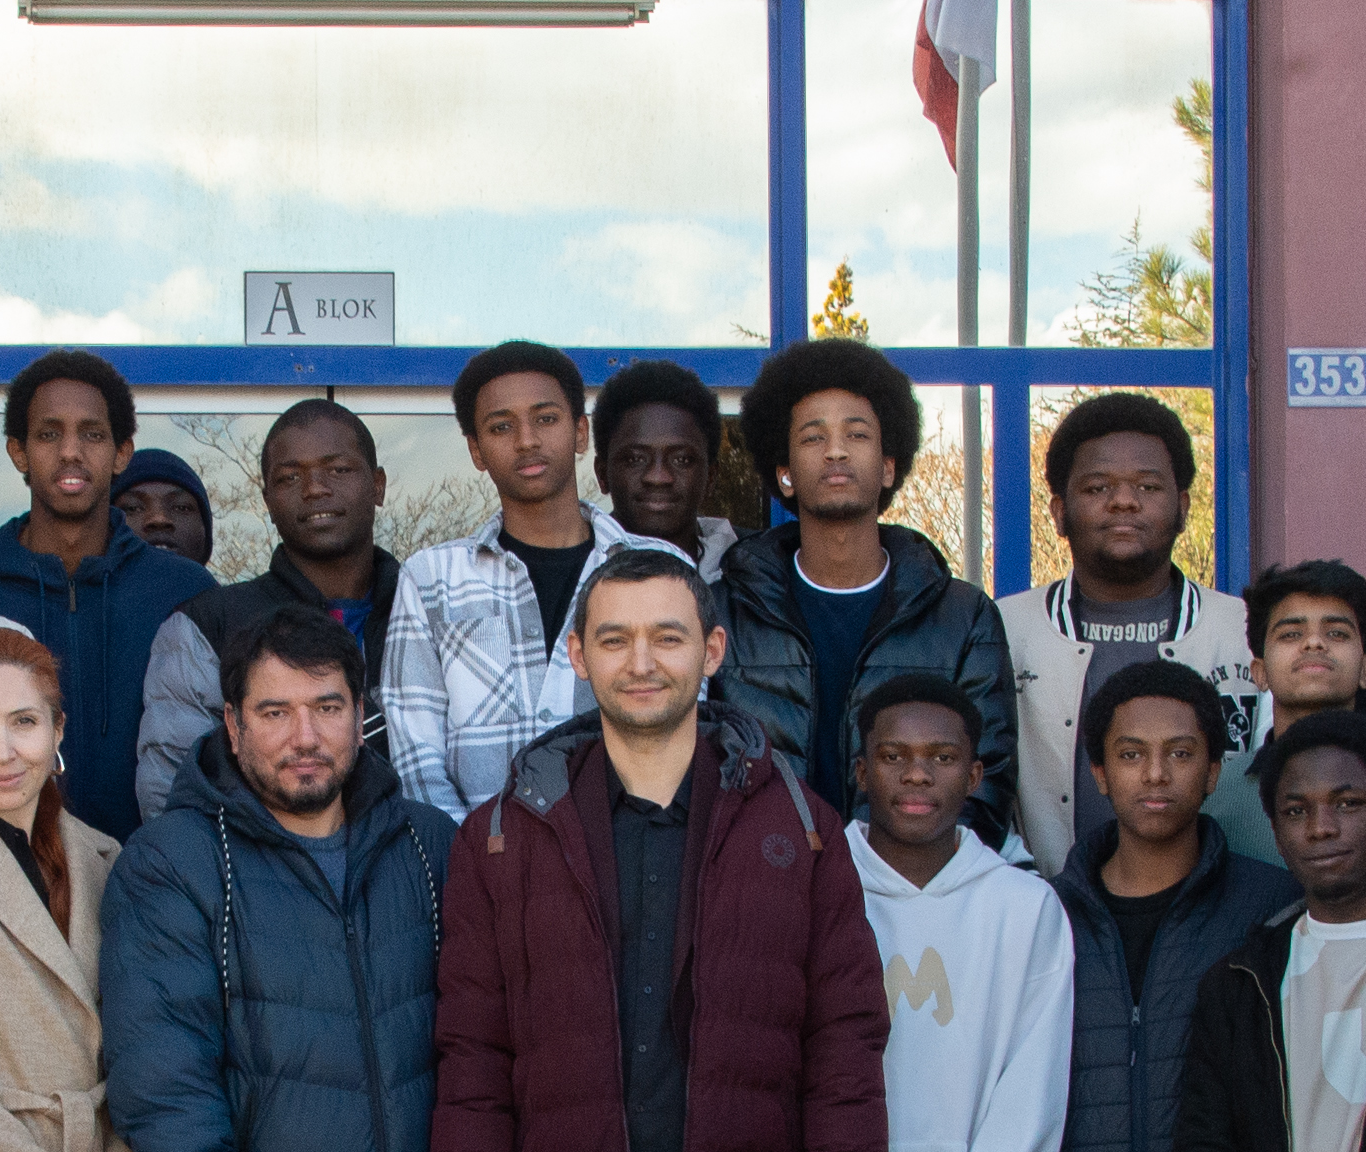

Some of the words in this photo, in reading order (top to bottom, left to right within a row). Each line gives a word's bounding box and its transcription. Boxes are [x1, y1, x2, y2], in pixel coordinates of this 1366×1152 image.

[260, 281, 306, 335] A
[315, 298, 377, 322] BLOK
[1294, 355, 1366, 396] 353
